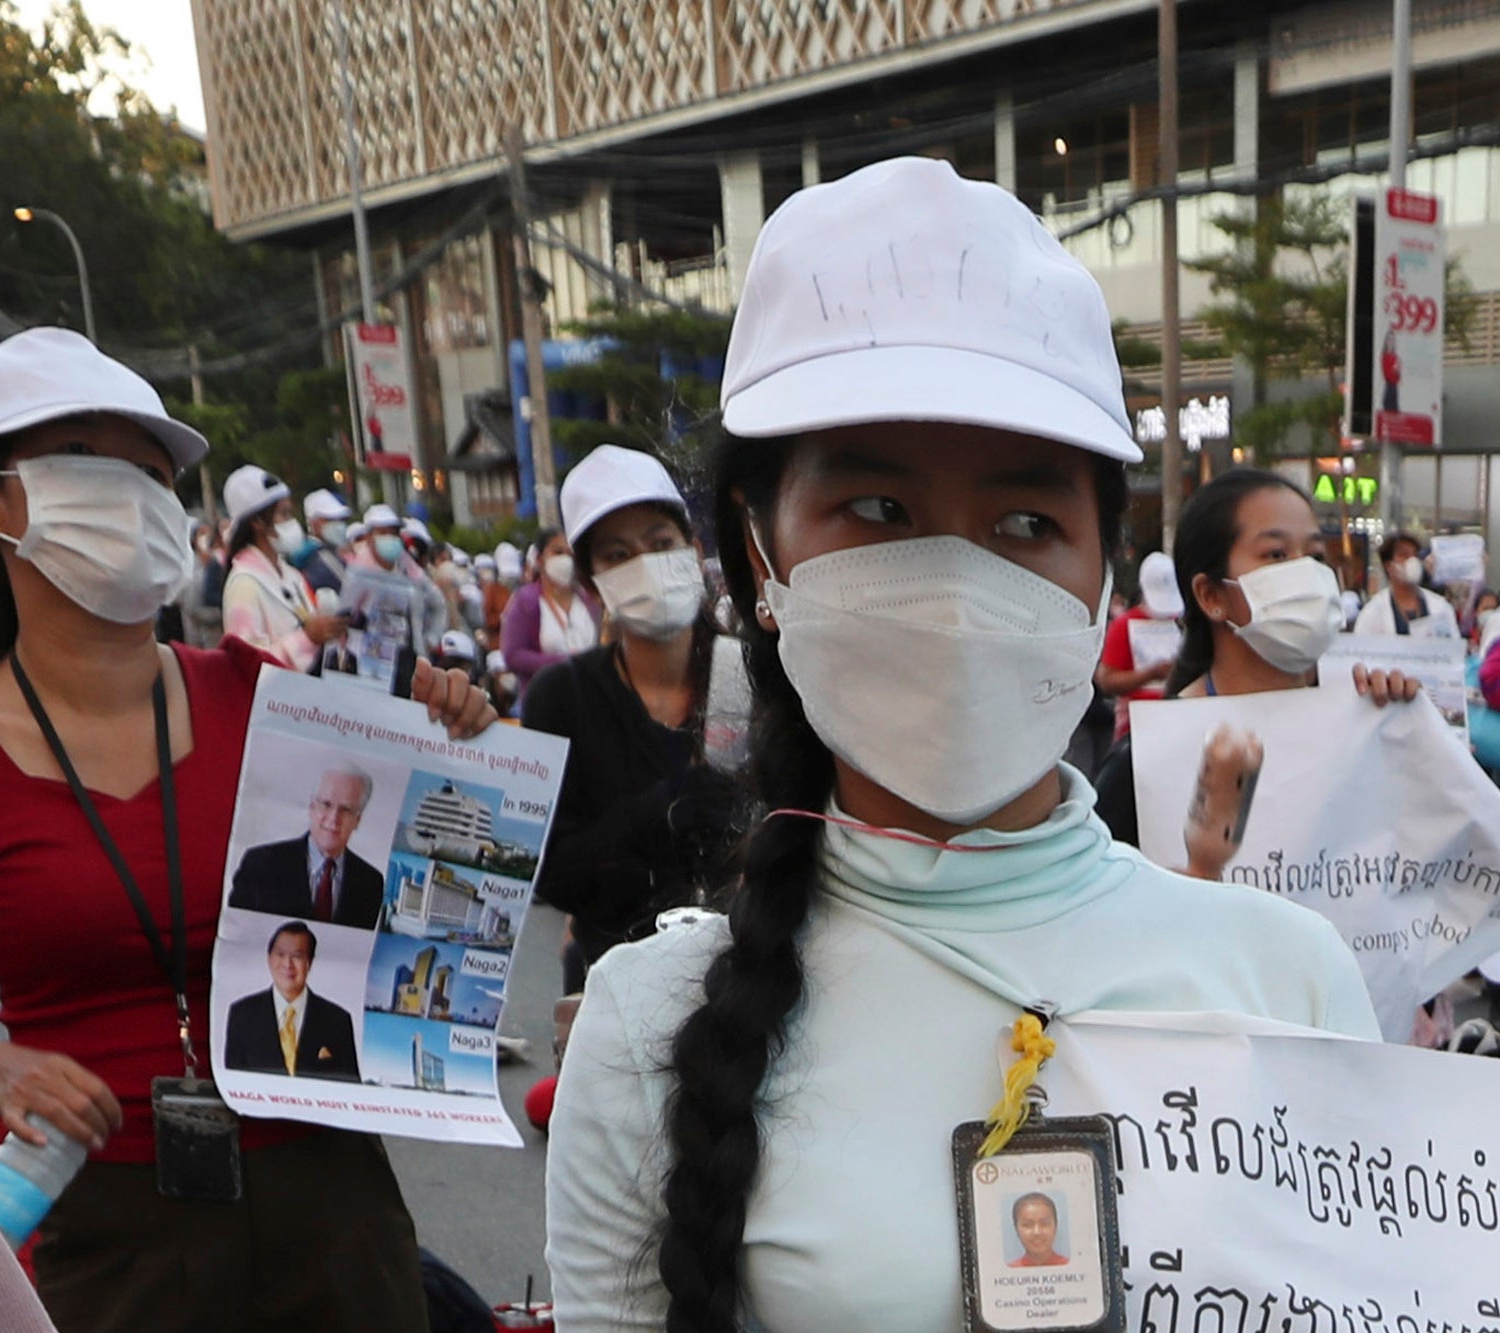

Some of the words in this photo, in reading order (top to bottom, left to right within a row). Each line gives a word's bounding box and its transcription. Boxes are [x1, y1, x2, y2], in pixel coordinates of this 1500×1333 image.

[463, 952, 507, 976] Naga2
[450, 1031, 492, 1051] Naga3
[1026, 1309, 1059, 1319] Dealer
